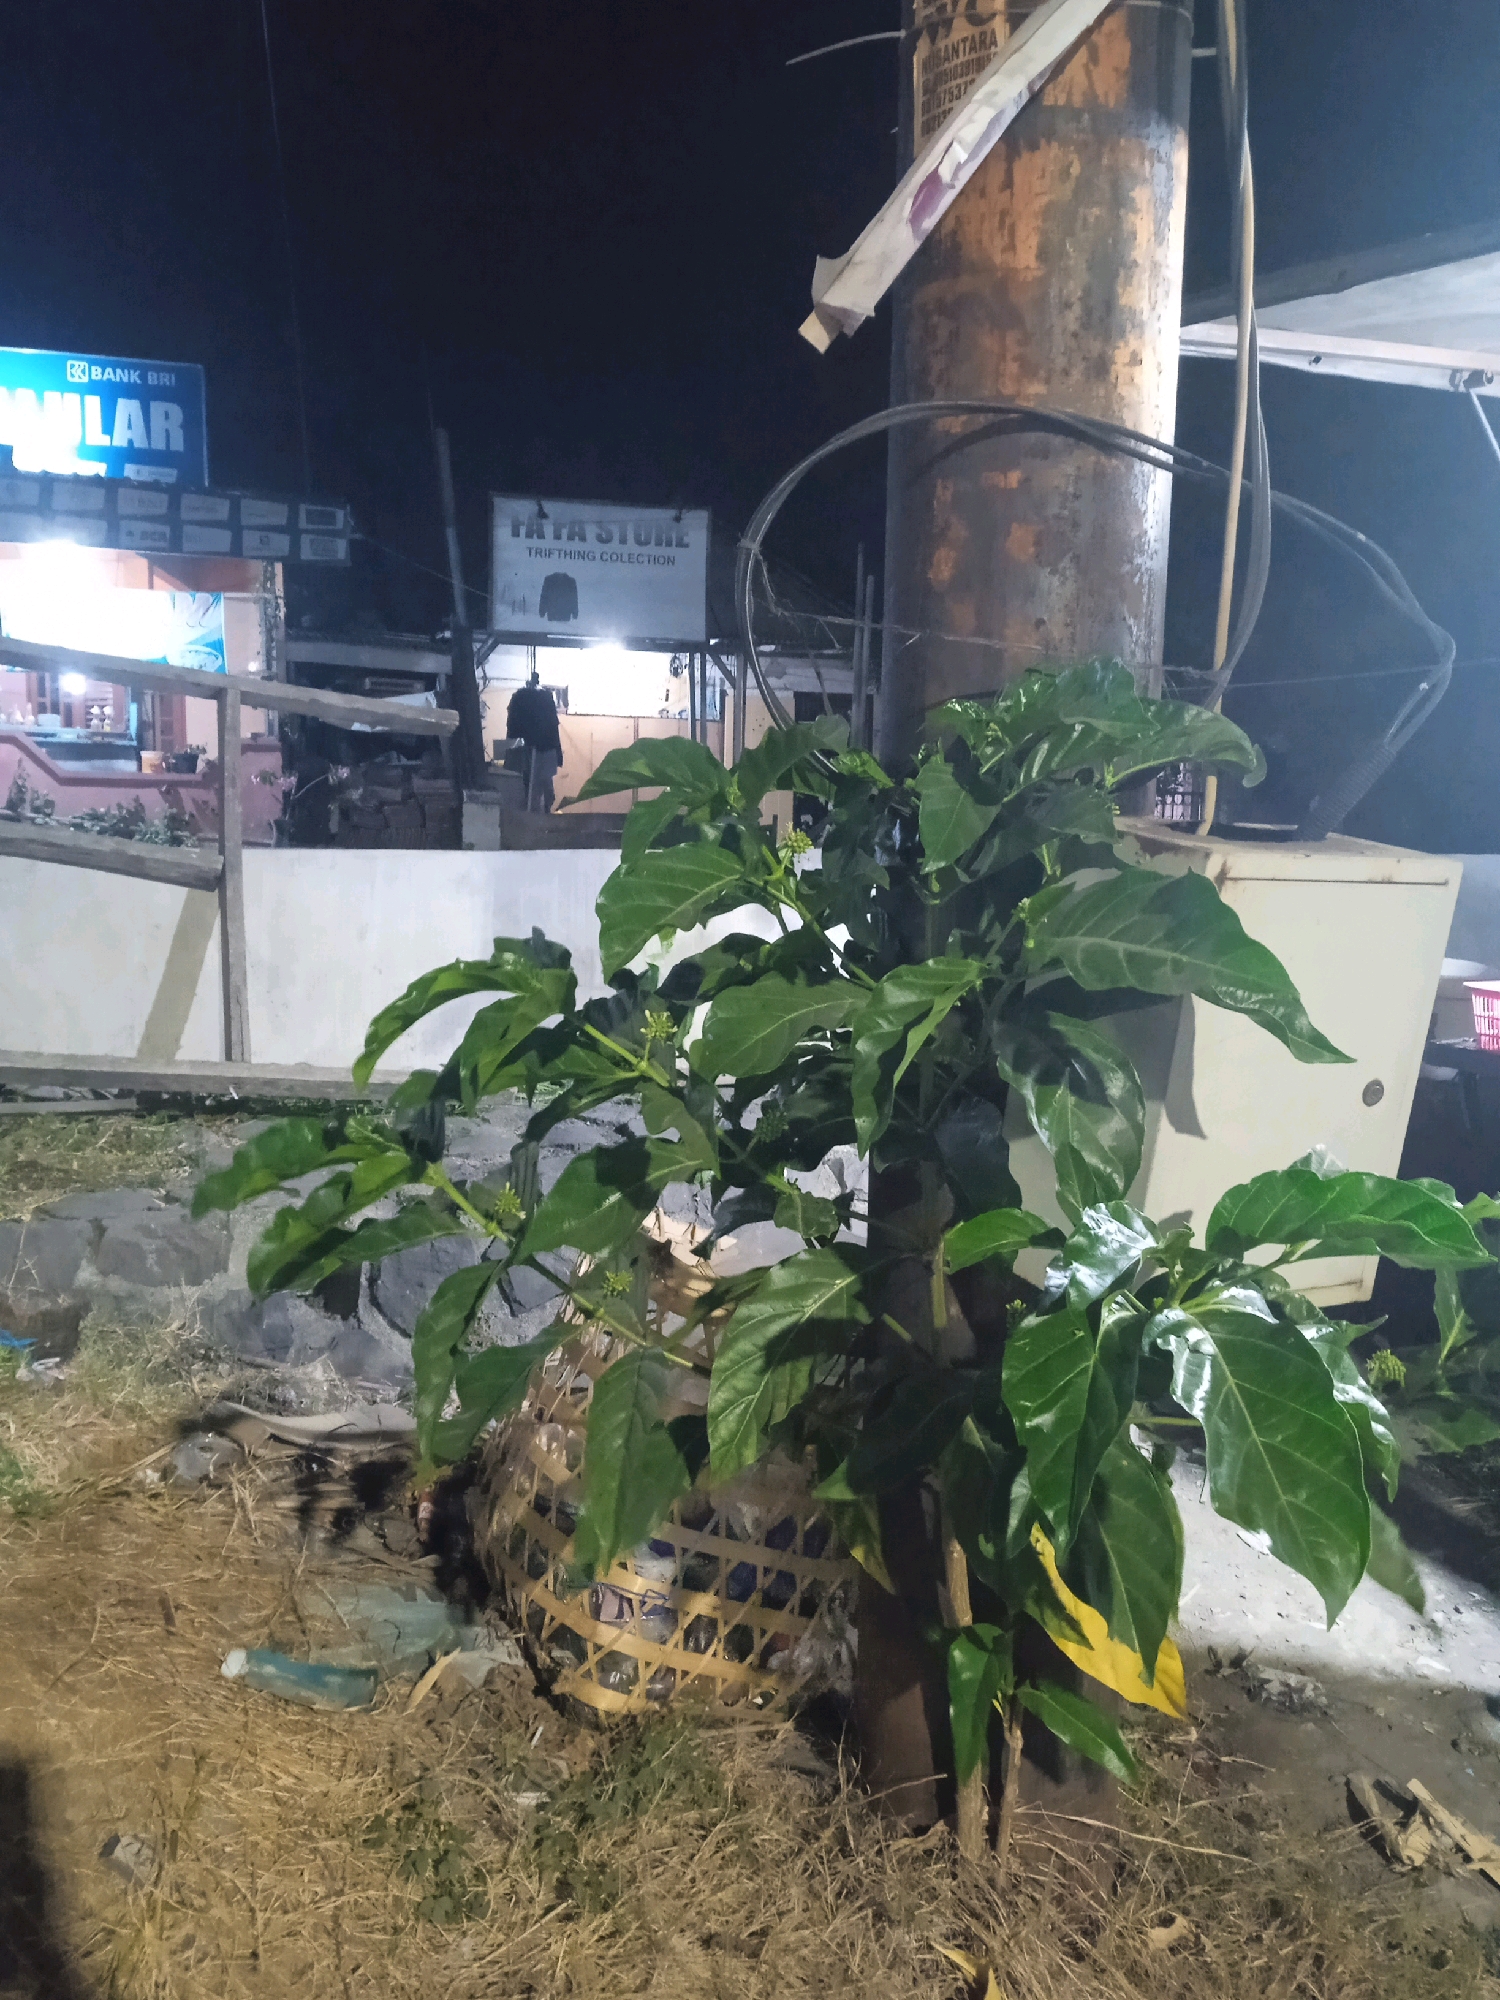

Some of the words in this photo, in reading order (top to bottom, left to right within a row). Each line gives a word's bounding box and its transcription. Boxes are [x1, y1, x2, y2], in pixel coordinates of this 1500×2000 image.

[90, 365, 142, 384] BANK
[147, 370, 176, 387] BRI
[595, 520, 690, 549] STORE
[526, 546, 597, 562] TRIFTHING
[600, 550, 676, 566] COLECTION
